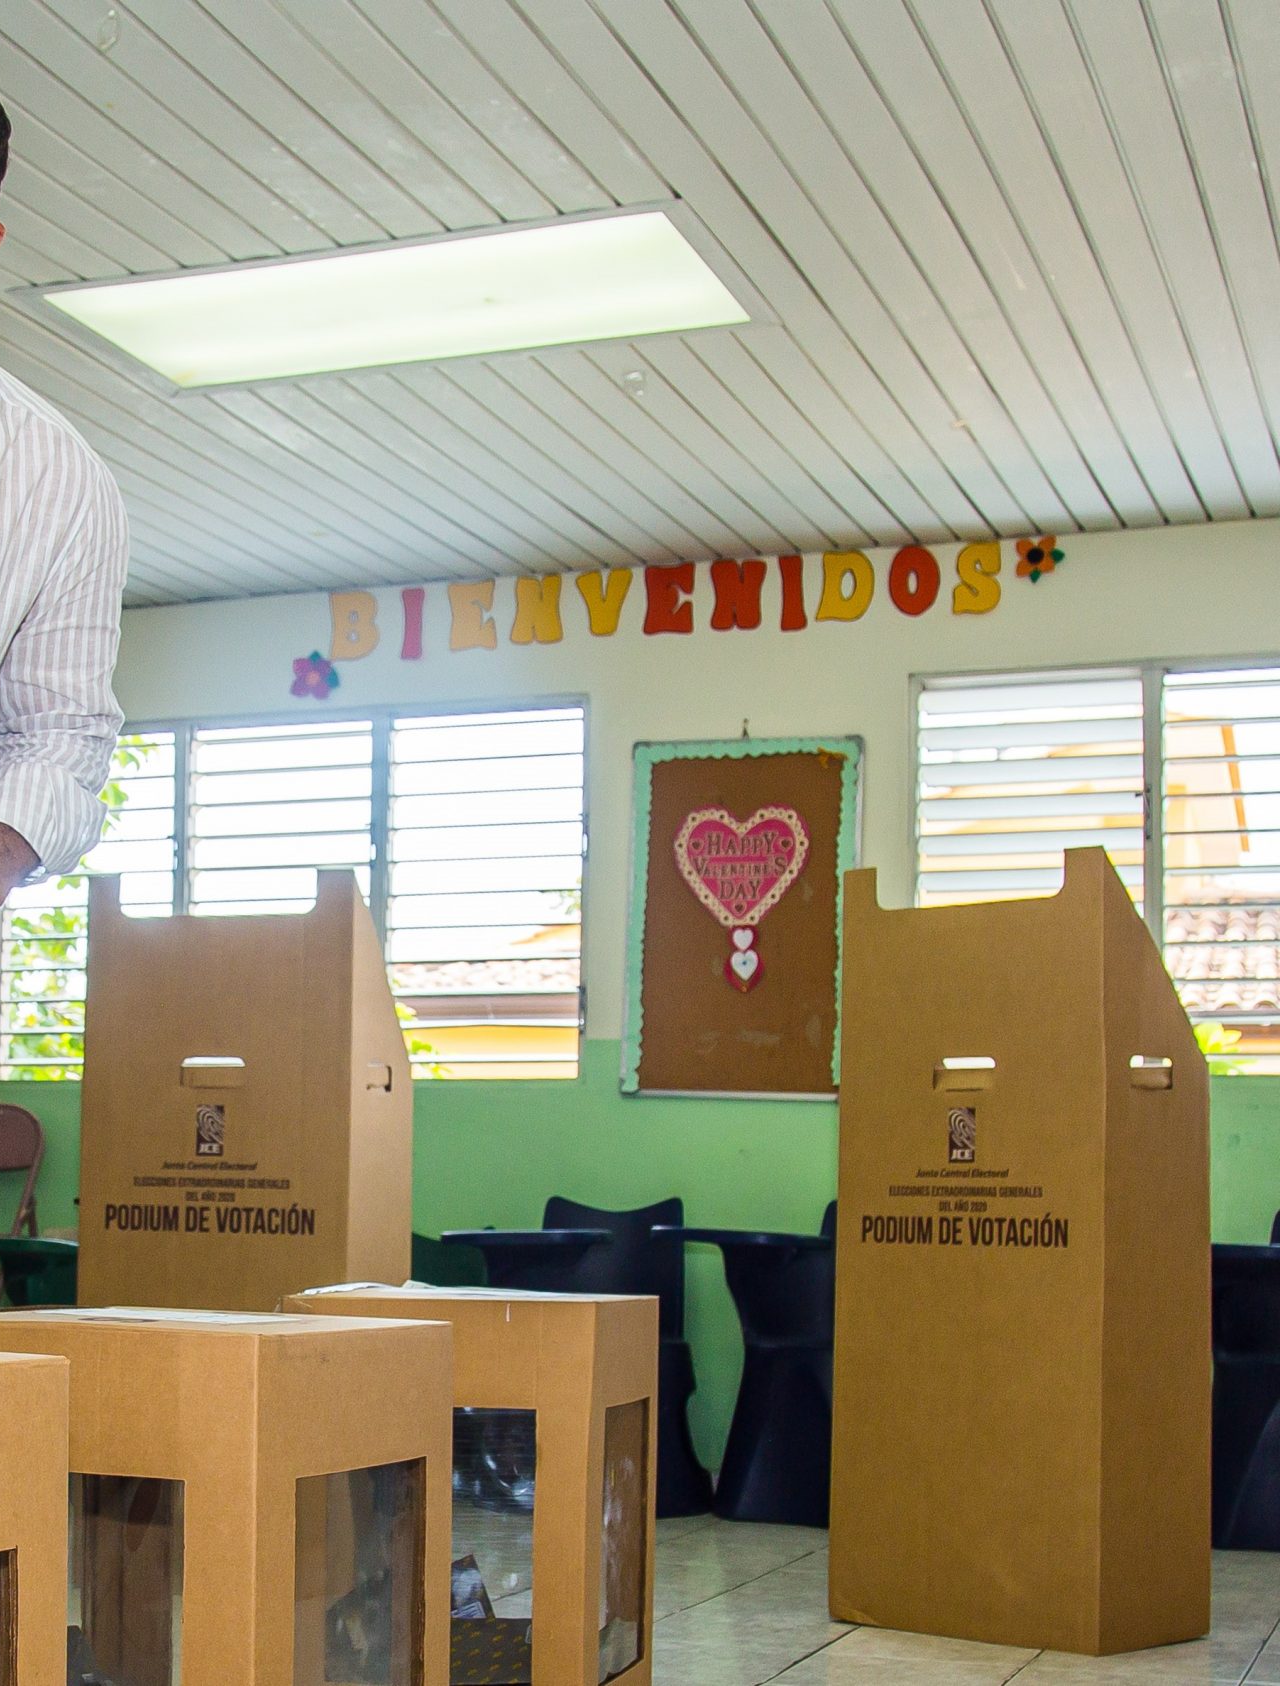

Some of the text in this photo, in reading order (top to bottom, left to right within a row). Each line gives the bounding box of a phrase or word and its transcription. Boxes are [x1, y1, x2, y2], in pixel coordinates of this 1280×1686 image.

[329, 541, 1002, 661] BIENVENIDOS
[706, 831, 777, 856] HAPPY
[720, 879, 761, 900] DAY
[950, 1149, 973, 1161] JCE
[104, 1203, 315, 1235] PODIUM DE VOTACIÓN
[861, 1212, 1068, 1248] PODIUM DE VOTACIÓN
